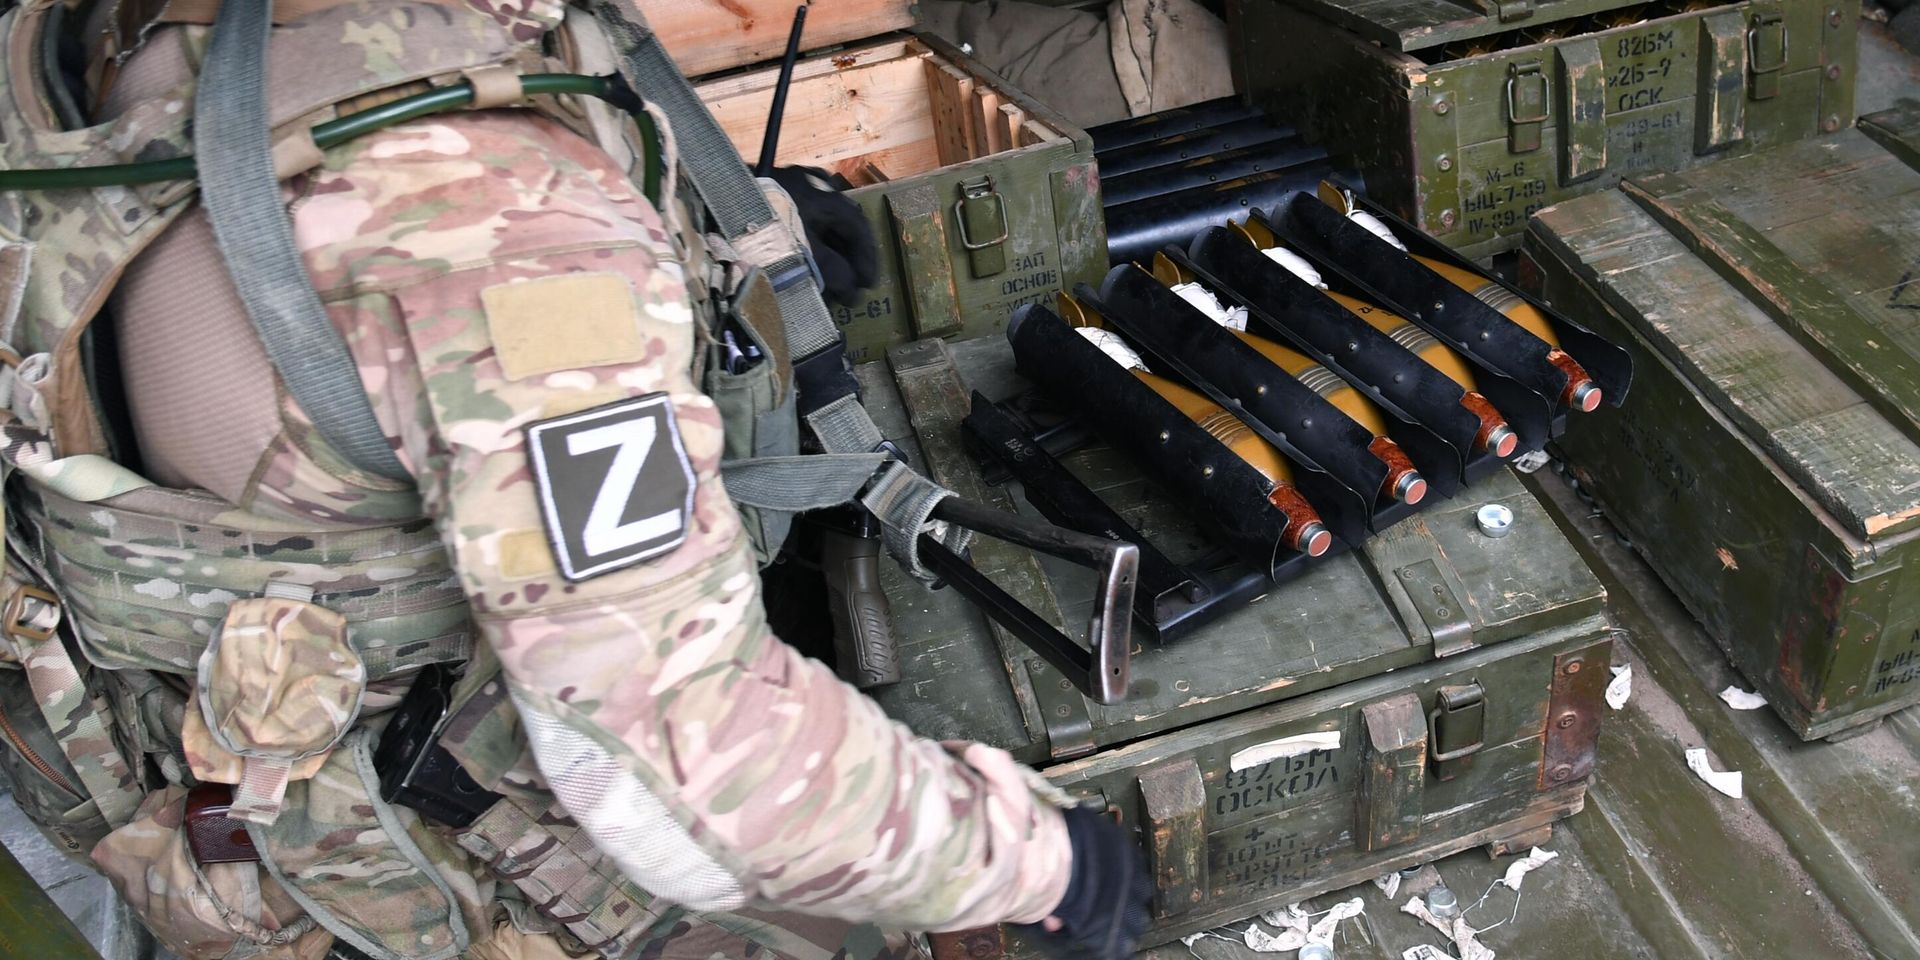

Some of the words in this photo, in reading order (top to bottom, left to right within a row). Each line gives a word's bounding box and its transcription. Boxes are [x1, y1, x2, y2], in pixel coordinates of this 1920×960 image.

[1618, 86, 1664, 112] ОСК
[1486, 161, 1525, 185] М-6
[1002, 269, 1057, 296] ОСНОВ
[566, 416, 682, 557] Z
[1216, 766, 1339, 816] ОСКОЛ
